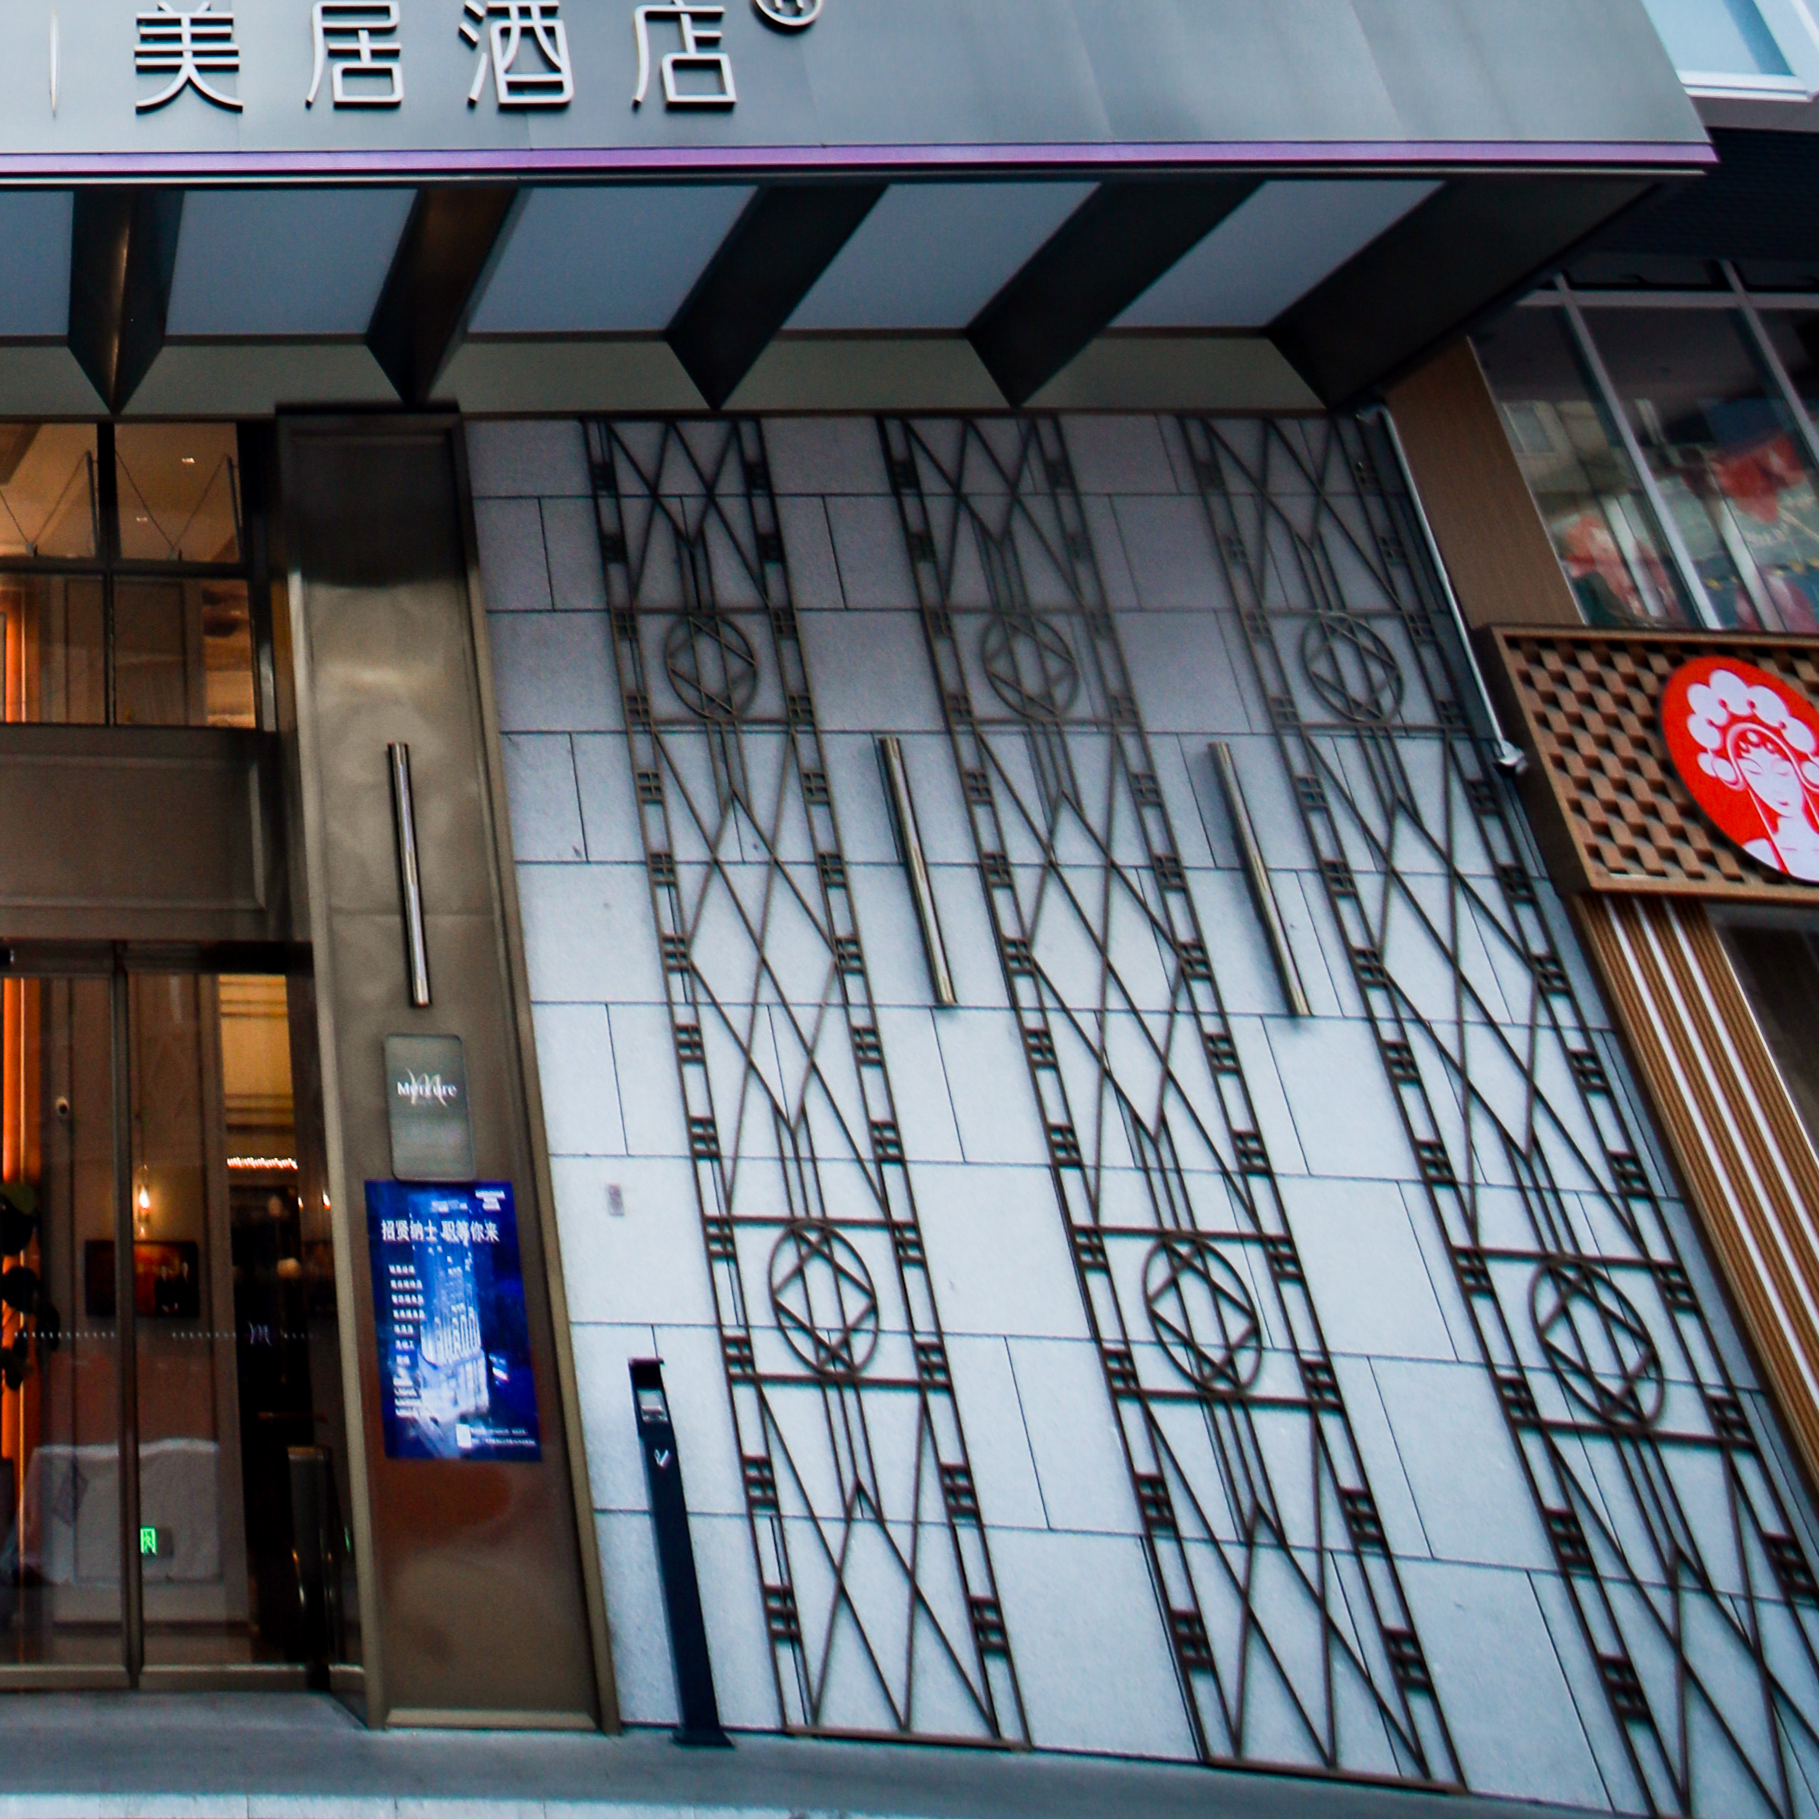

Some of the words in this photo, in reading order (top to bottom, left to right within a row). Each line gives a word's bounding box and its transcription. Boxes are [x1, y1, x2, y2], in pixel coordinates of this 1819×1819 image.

[396, 1080, 459, 1098] Mercure
[380, 1219, 438, 1244] 招贤纳士
[440, 1219, 501, 1244] 职等你来
